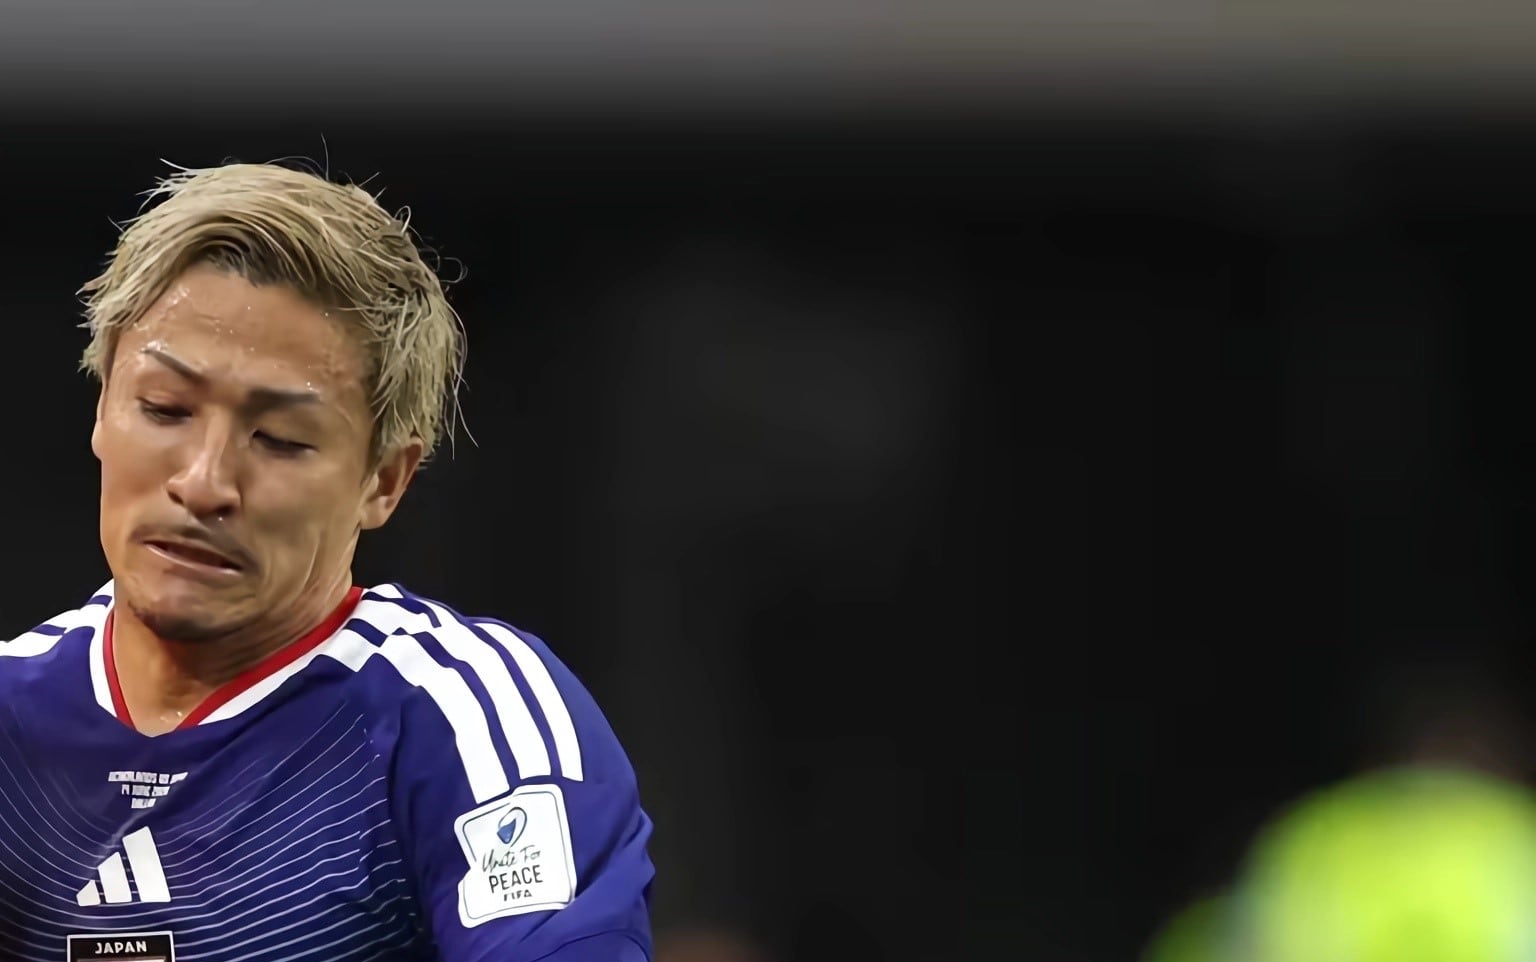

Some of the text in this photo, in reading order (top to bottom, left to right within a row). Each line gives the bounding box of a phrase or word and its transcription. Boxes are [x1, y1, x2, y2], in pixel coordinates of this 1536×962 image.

[488, 864, 544, 894] PEACE
[503, 889, 533, 901] FIFA
[95, 941, 147, 955] JAPAN
